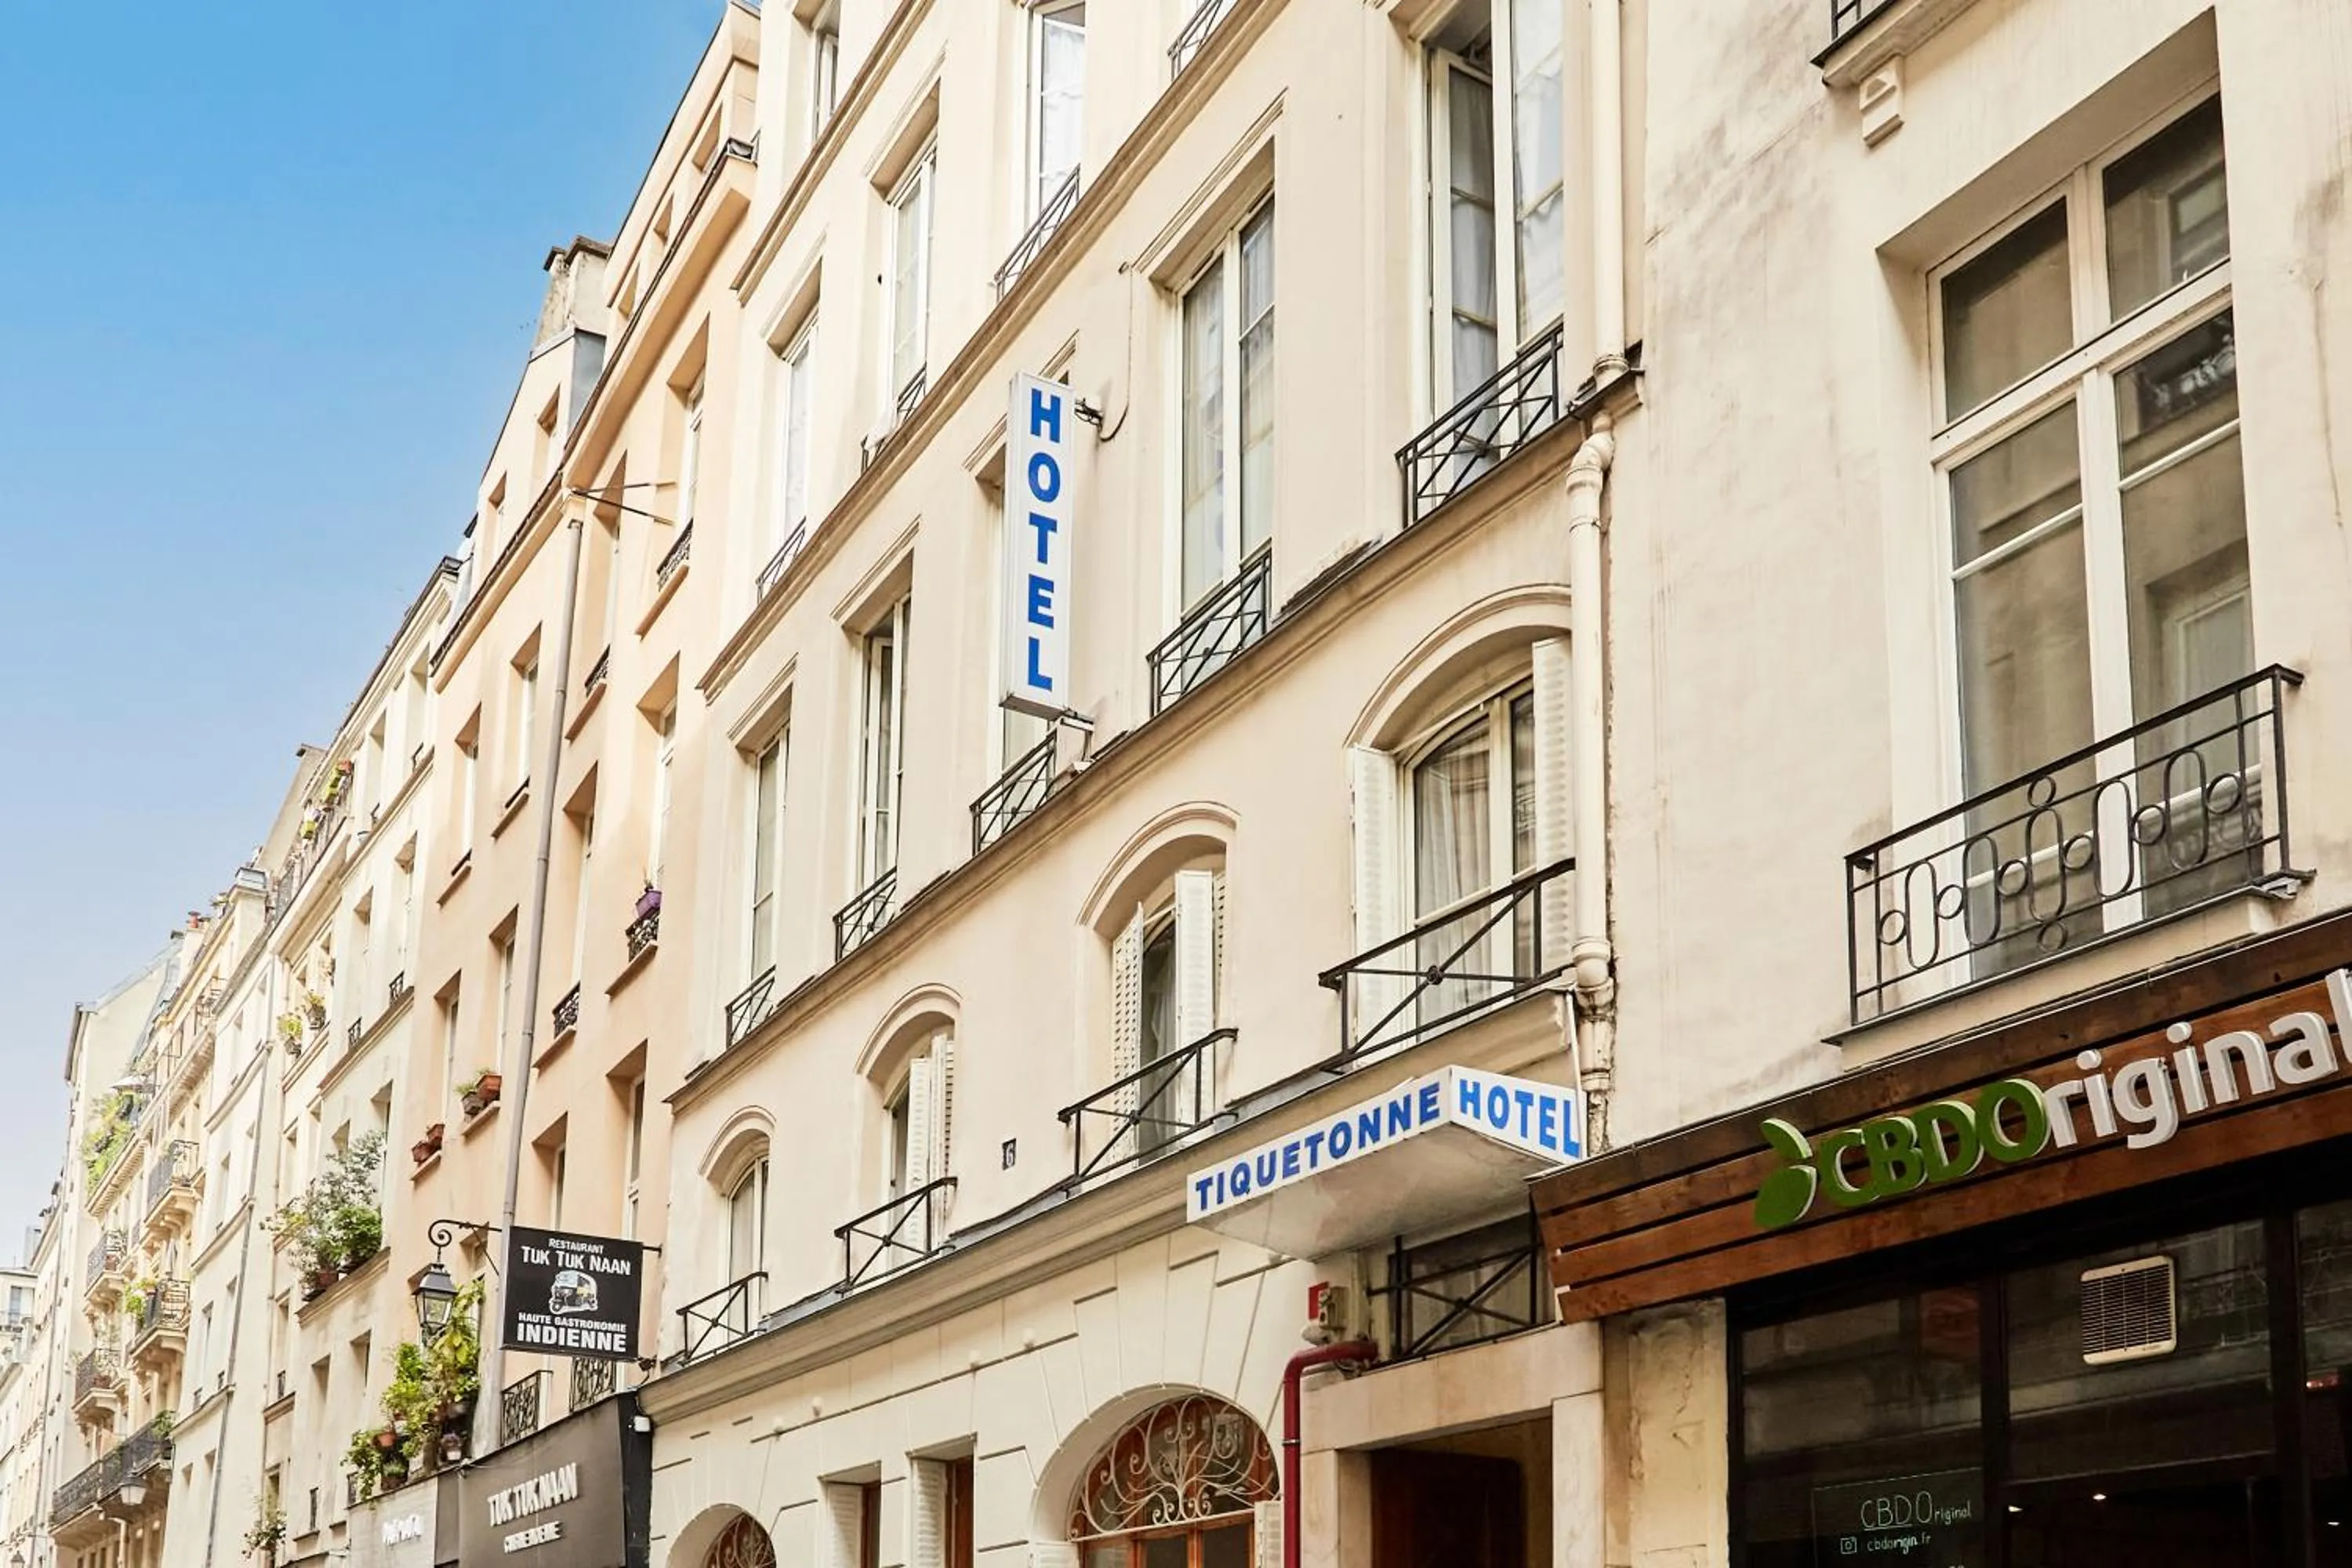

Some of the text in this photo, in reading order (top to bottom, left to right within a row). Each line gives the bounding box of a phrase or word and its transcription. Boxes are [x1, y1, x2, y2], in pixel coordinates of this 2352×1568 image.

[1028, 387, 1061, 691] HOTEL
[1459, 1078, 1581, 1158] HOTEL
[1195, 1081, 1441, 1211] TIQUETONNE
[521, 1246, 631, 1276] TUK TUK NAAN
[549, 1238, 604, 1254] RESTAURANT
[517, 1323, 627, 1352] INDIENNE
[518, 1312, 627, 1333] HAUTE GASTRONOMIE
[487, 1487, 514, 1527] TUK
[513, 1478, 540, 1519] TUK
